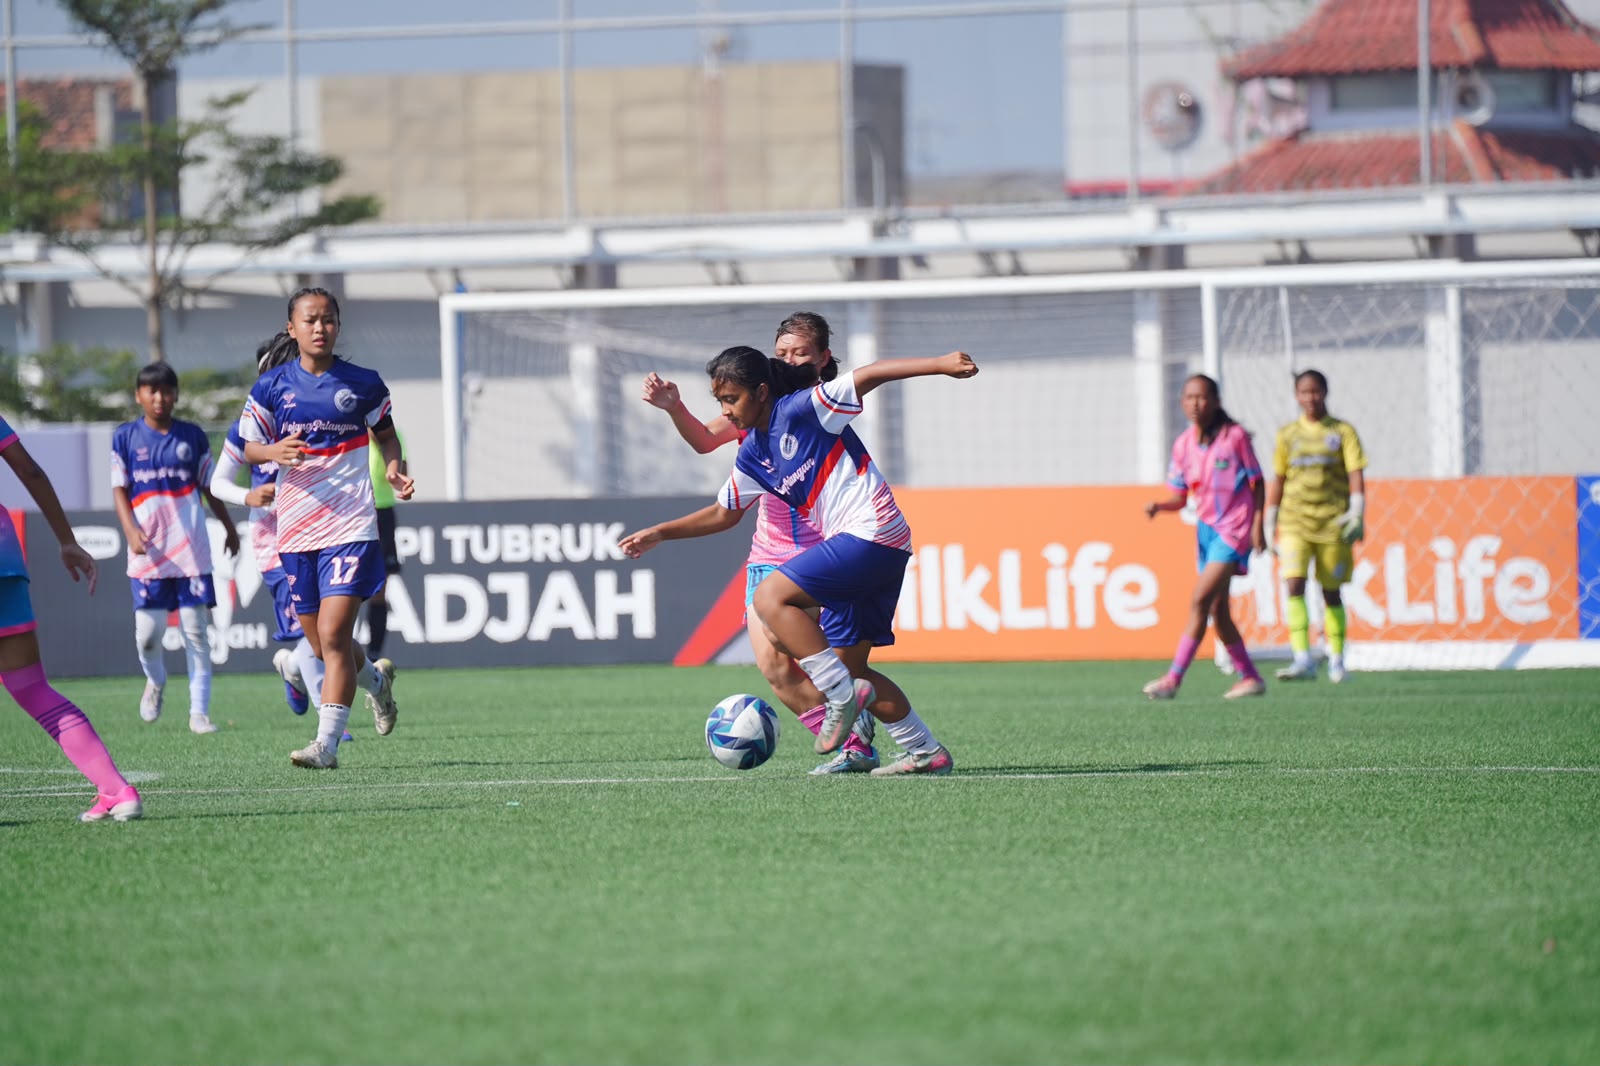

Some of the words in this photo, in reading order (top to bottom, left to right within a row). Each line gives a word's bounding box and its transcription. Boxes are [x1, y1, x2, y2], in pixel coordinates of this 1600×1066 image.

[329, 555, 359, 585] 17
[442, 521, 626, 564] TUBRUK
[354, 568, 656, 643] ADJAH
[890, 541, 1160, 634] ilkLife
